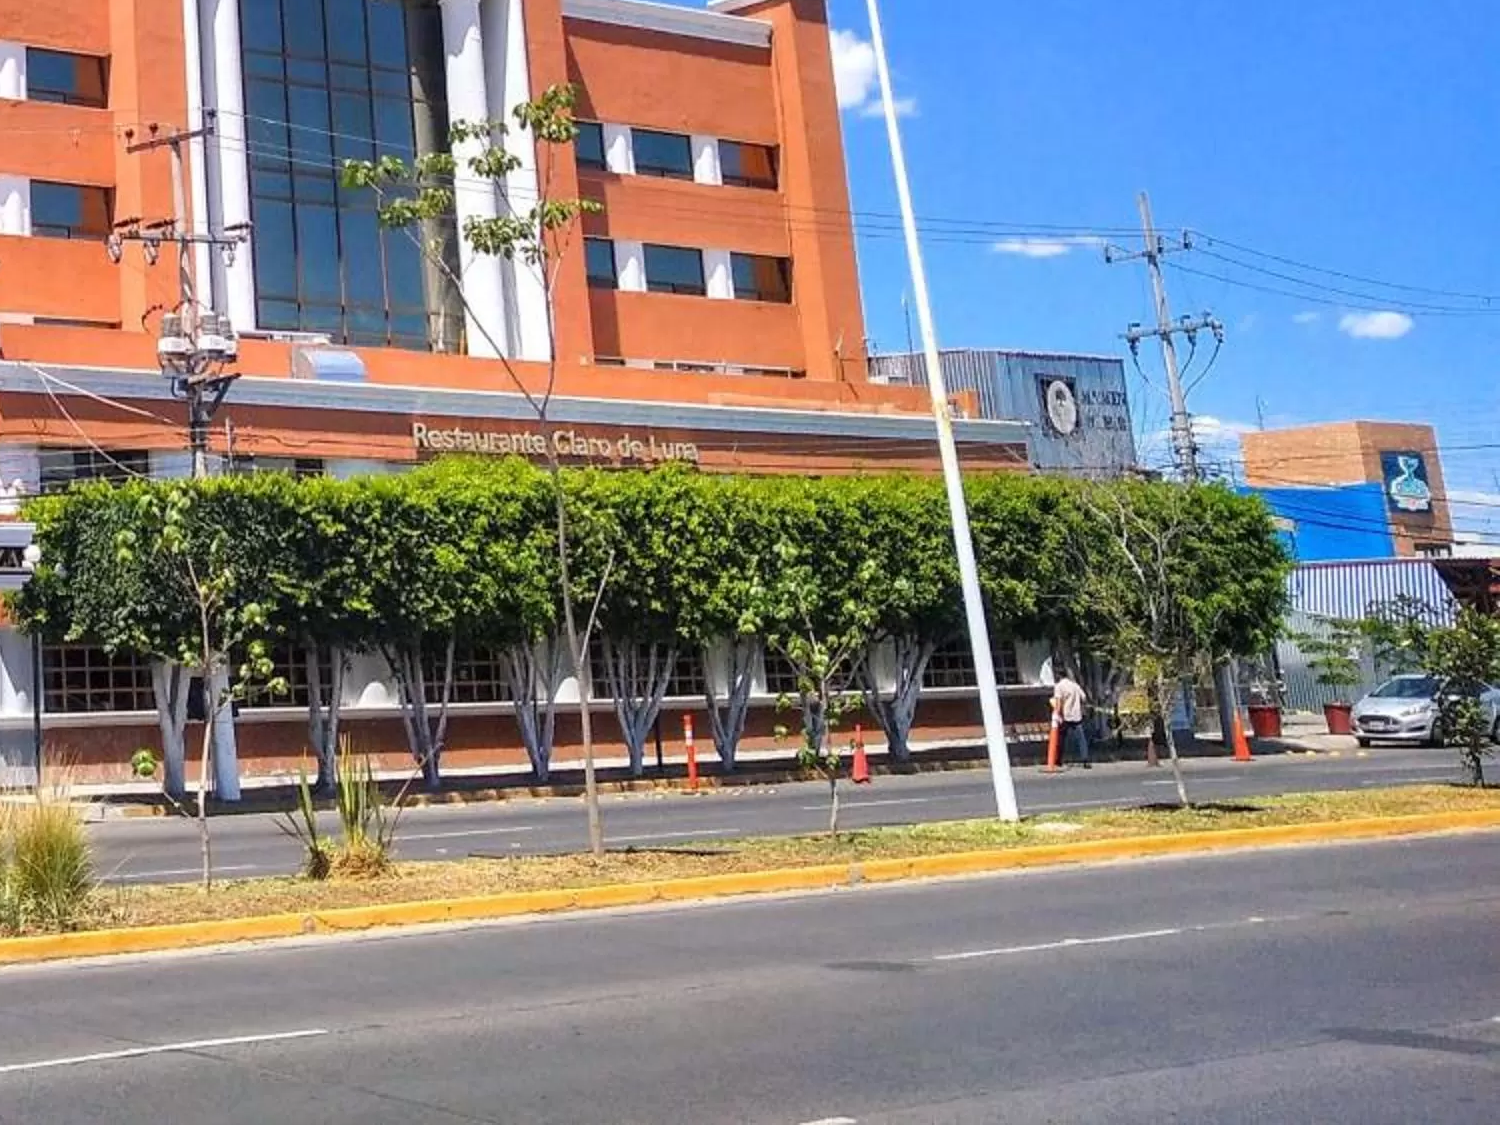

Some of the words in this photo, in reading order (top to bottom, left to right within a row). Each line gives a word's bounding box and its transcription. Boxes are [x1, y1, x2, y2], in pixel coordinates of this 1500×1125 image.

[412, 422, 547, 454] Restaurante
[552, 429, 611, 456] Claro
[617, 433, 644, 458] de
[648, 434, 699, 462] Luna
